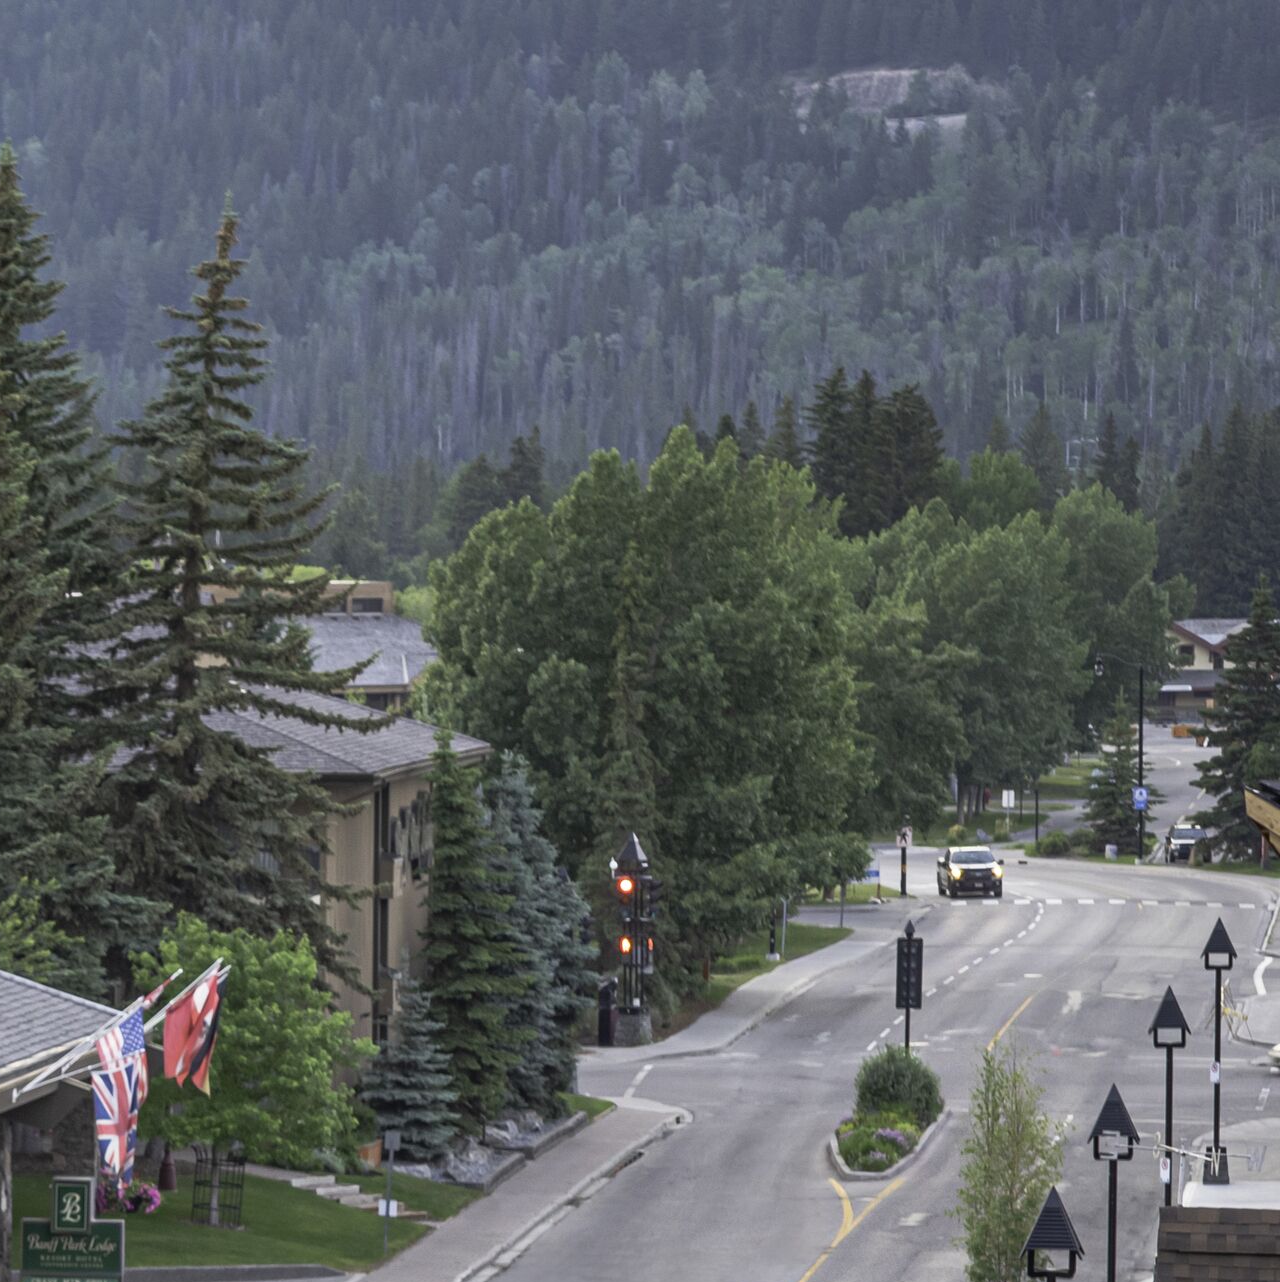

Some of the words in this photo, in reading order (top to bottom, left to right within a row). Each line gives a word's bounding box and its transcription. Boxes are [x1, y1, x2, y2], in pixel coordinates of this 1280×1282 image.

[27, 1233, 59, 1253] Banff
[60, 1234, 88, 1254] Park
[88, 1236, 116, 1256] Lodge
